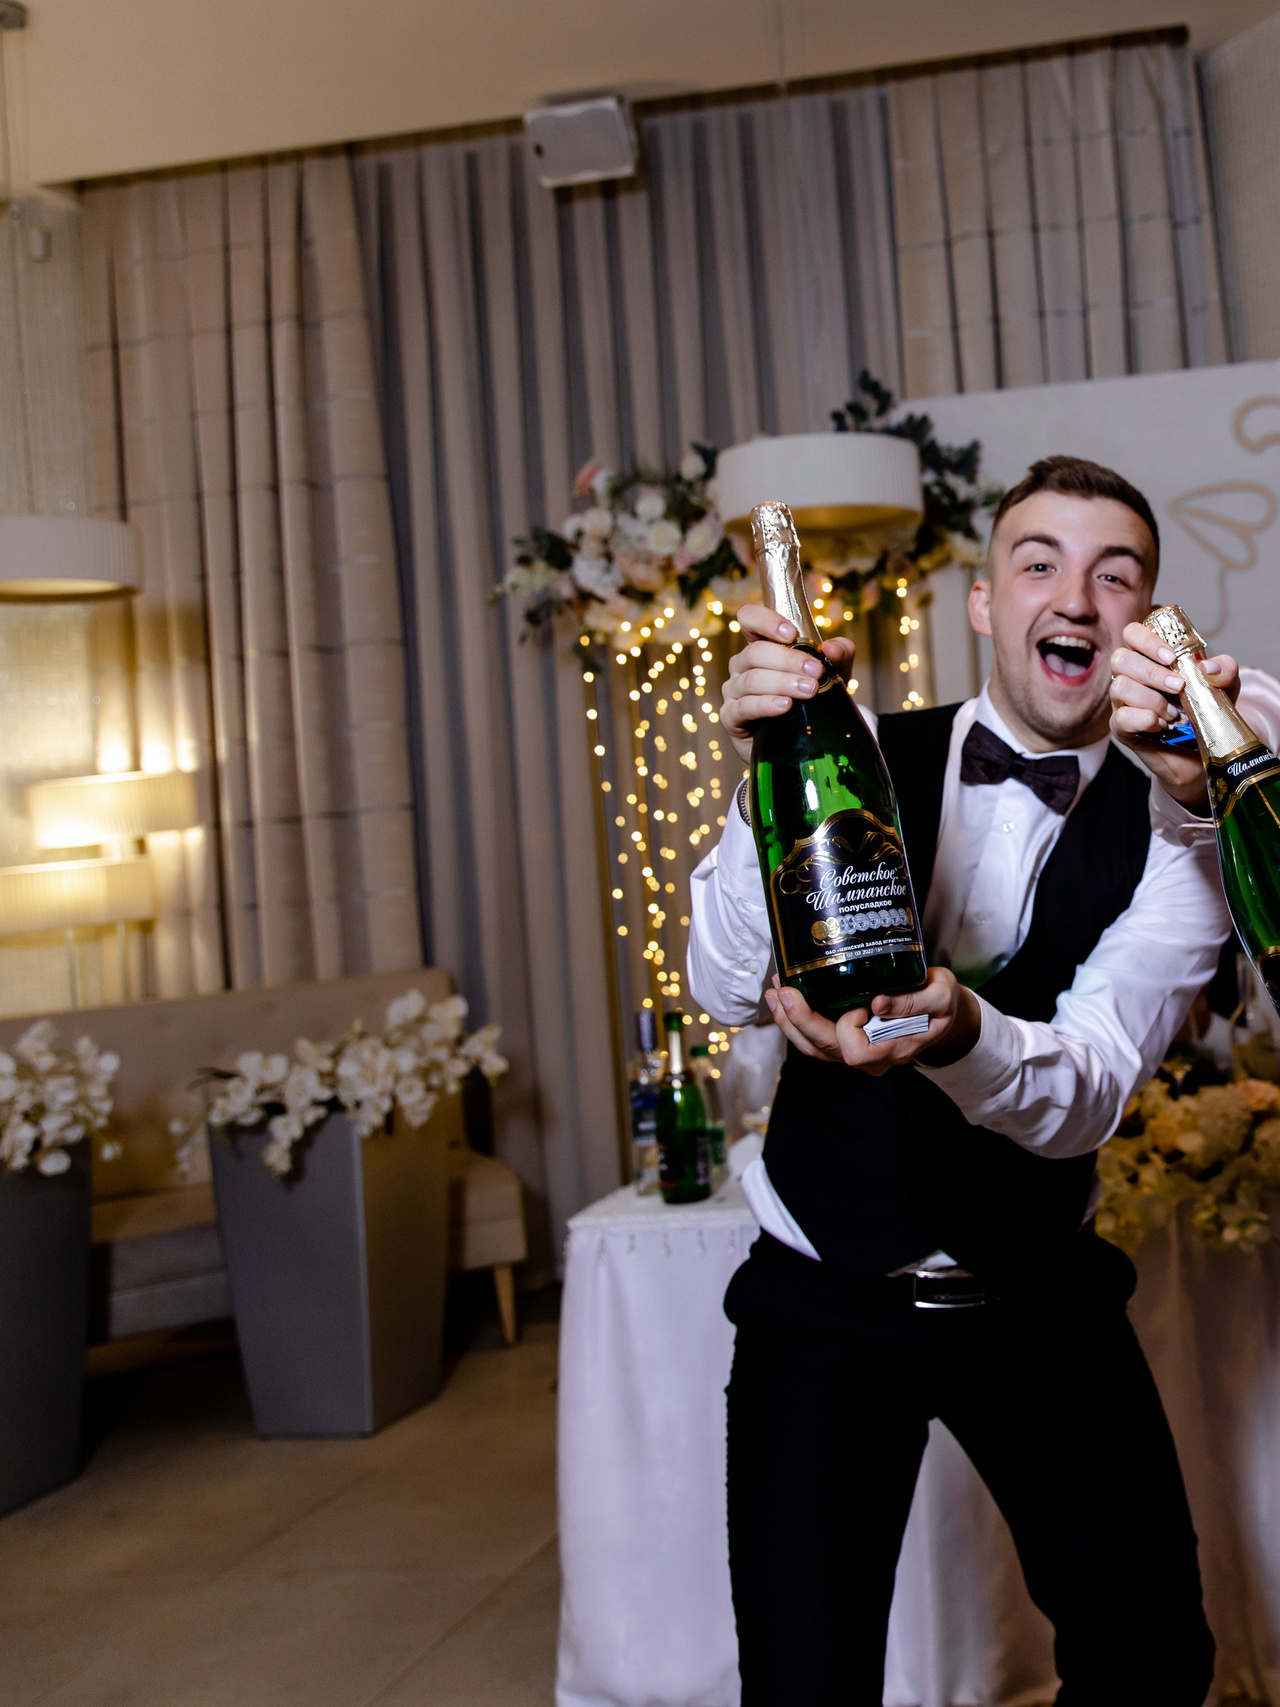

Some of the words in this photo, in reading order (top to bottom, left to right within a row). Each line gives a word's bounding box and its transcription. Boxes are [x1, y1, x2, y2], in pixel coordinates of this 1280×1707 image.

[819, 861, 896, 891] Советское
[806, 876, 907, 911] Шампанское
[838, 899, 893, 914] полусладкое
